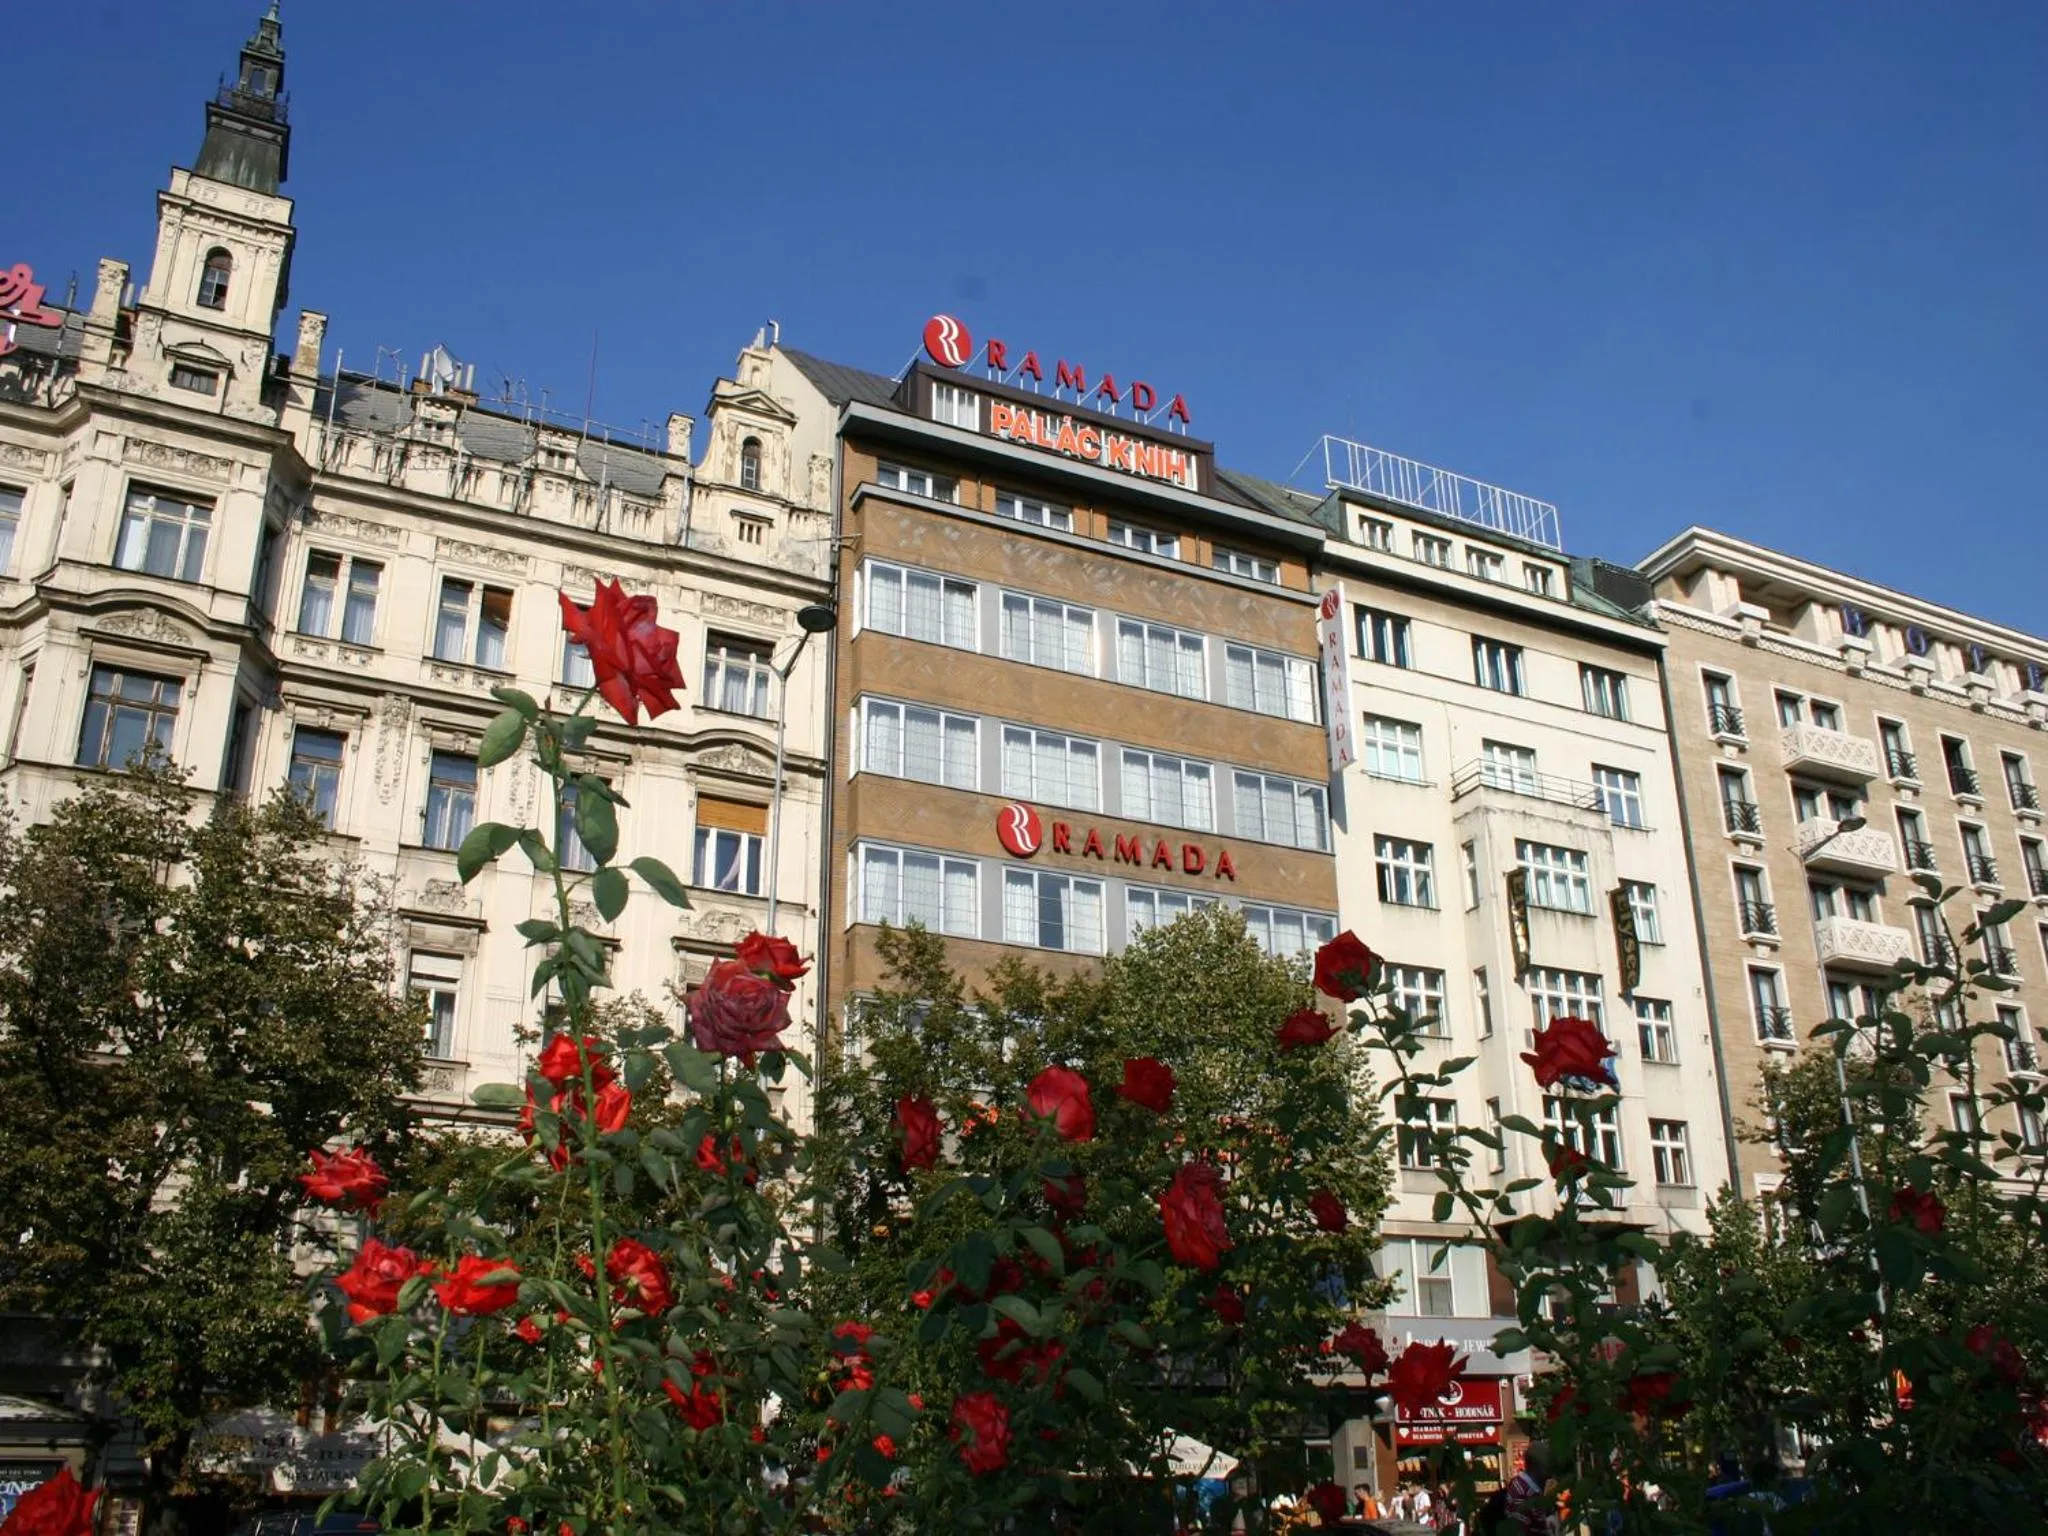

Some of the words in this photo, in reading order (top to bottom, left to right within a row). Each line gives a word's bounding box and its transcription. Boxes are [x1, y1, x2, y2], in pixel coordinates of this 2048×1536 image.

[987, 339, 1190, 423] RAMADA
[991, 402, 1101, 460] PALÁC
[1108, 434, 1187, 484] KNIH
[1328, 631, 1348, 763] RAMADA
[1052, 821, 1237, 881] RAMADA
